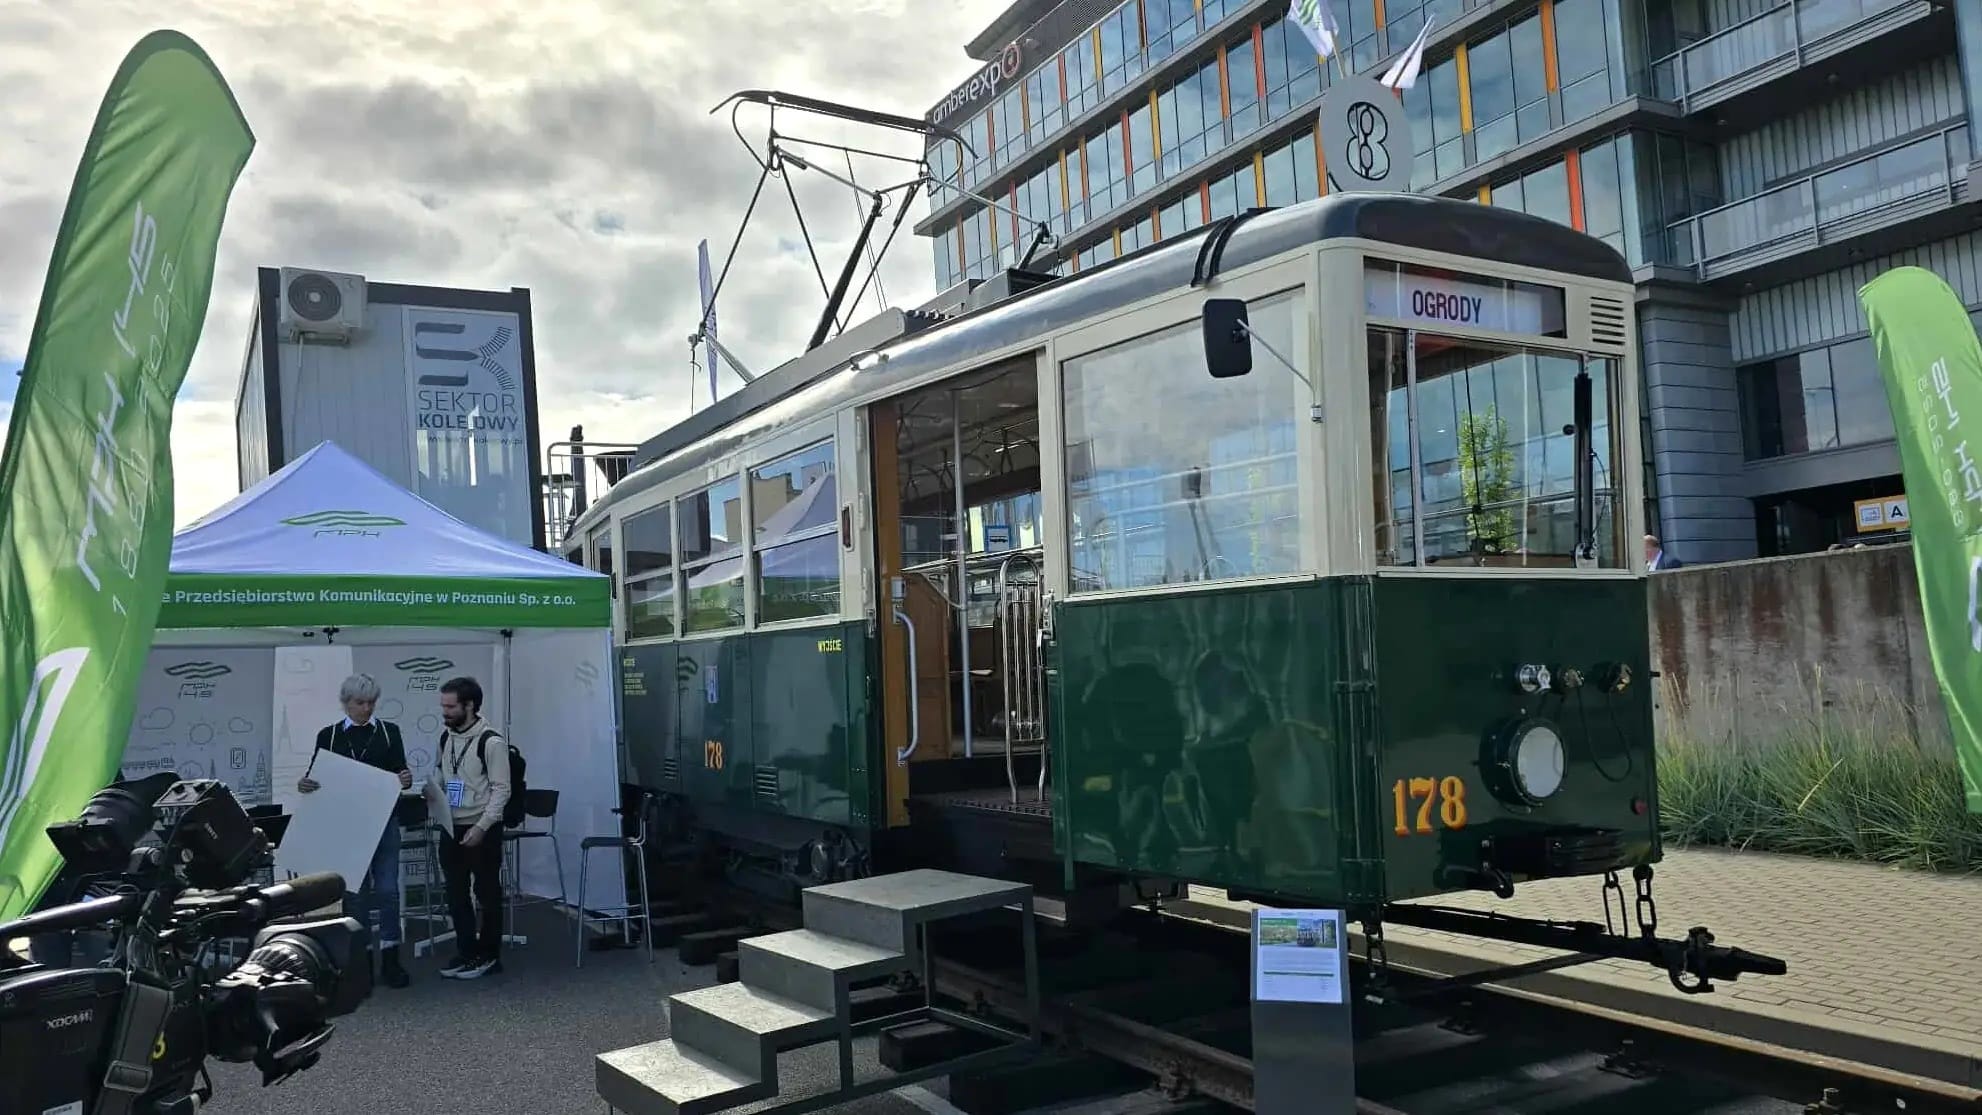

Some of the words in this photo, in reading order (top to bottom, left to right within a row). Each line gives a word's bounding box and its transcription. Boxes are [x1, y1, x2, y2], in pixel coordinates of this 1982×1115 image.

[1346, 101, 1391, 180] 8
[1412, 289, 1482, 324] OGRODY
[418, 390, 517, 414] SEKTOR
[419, 414, 519, 431] KOLEOWY
[1891, 505, 1904, 518] A
[175, 589, 315, 604] Przedsiębiorstwo
[319, 589, 433, 605] Komunikacyjne
[436, 593, 448, 603] w
[452, 591, 515, 605] Poznaniu
[519, 593, 540, 606] Sp.
[542, 595, 550, 605] z
[704, 740, 723, 770] 178
[1393, 775, 1468, 837] 178
